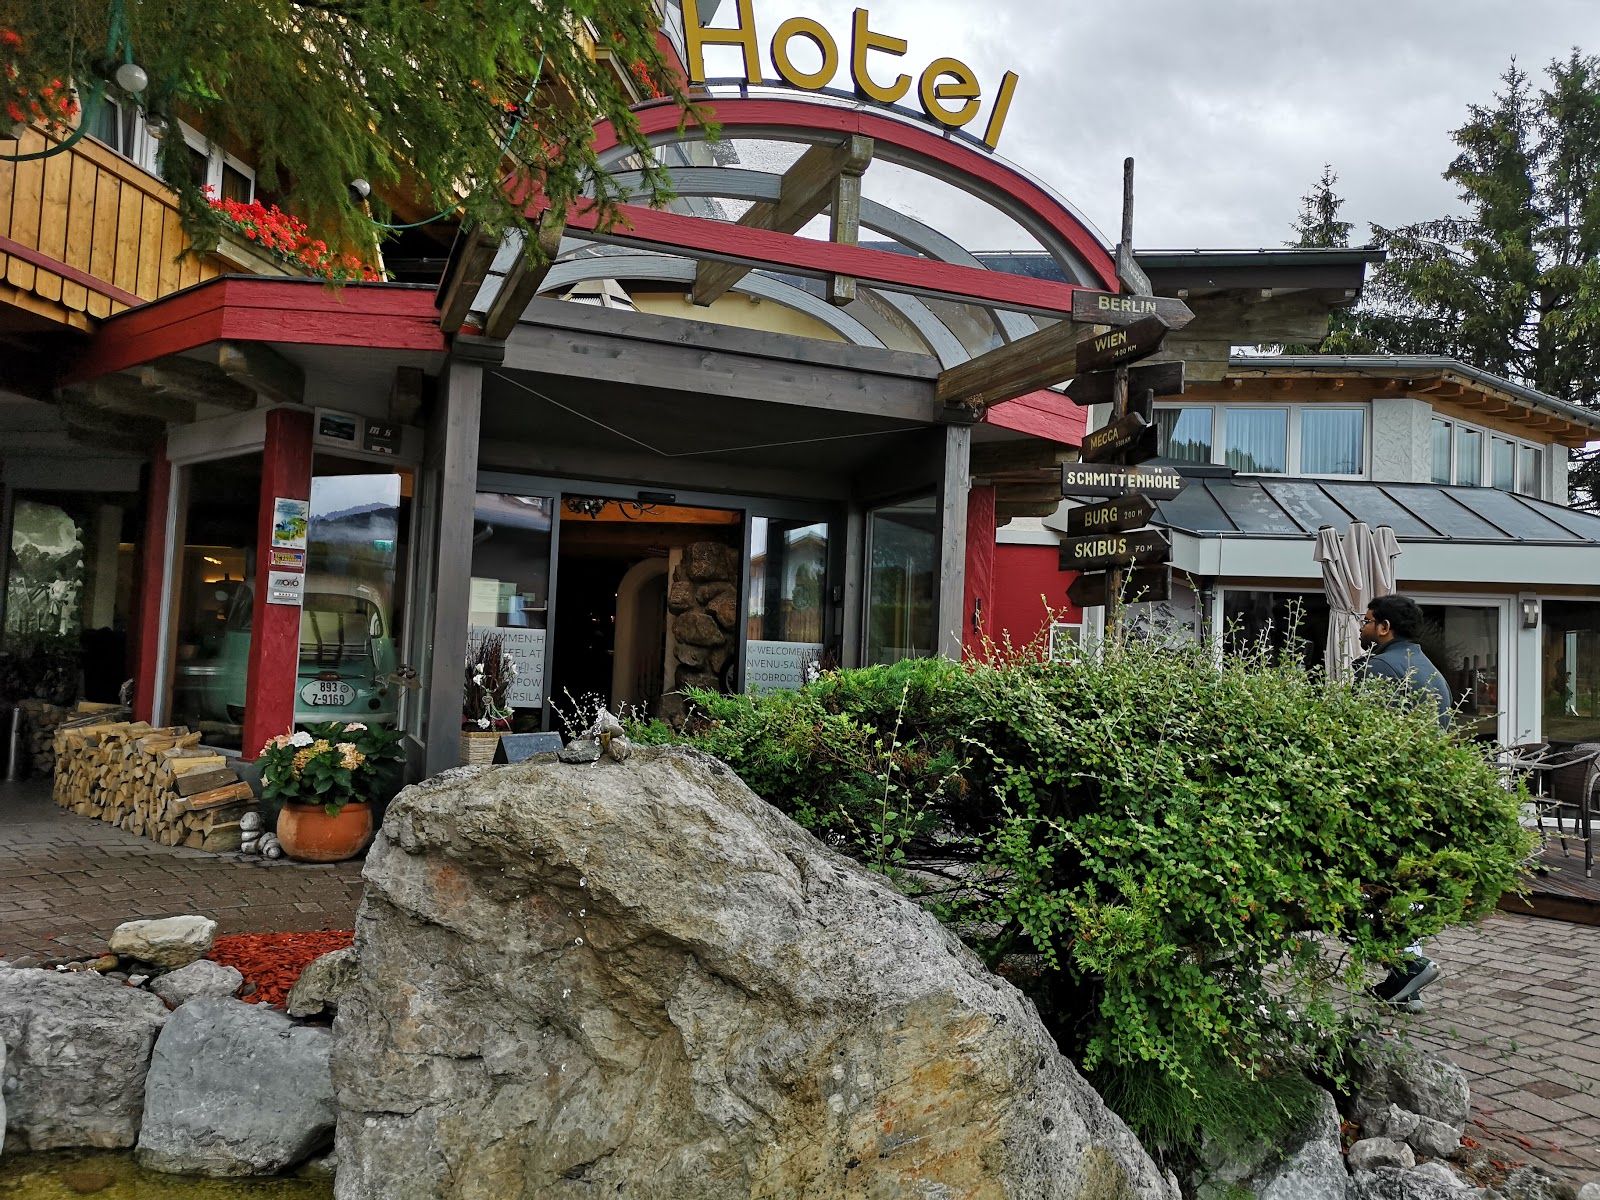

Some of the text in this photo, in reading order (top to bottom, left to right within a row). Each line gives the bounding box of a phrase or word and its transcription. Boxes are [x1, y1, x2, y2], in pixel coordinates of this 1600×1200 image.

[680, 0, 1019, 154] Hotel
[1098, 295, 1157, 313] BERLIN
[1095, 330, 1127, 352] WIEN
[1090, 427, 1119, 450] MECCA
[1067, 467, 1181, 489] SCHMITTENHÖHE
[1084, 506, 1143, 527] BURG 200 M
[1074, 538, 1127, 558] SKIBUS
[1146, 544, 1153, 552] M
[529, 649, 542, 658] AT
[320, 682, 338, 692] 893
[312, 693, 345, 705] Z-9169
